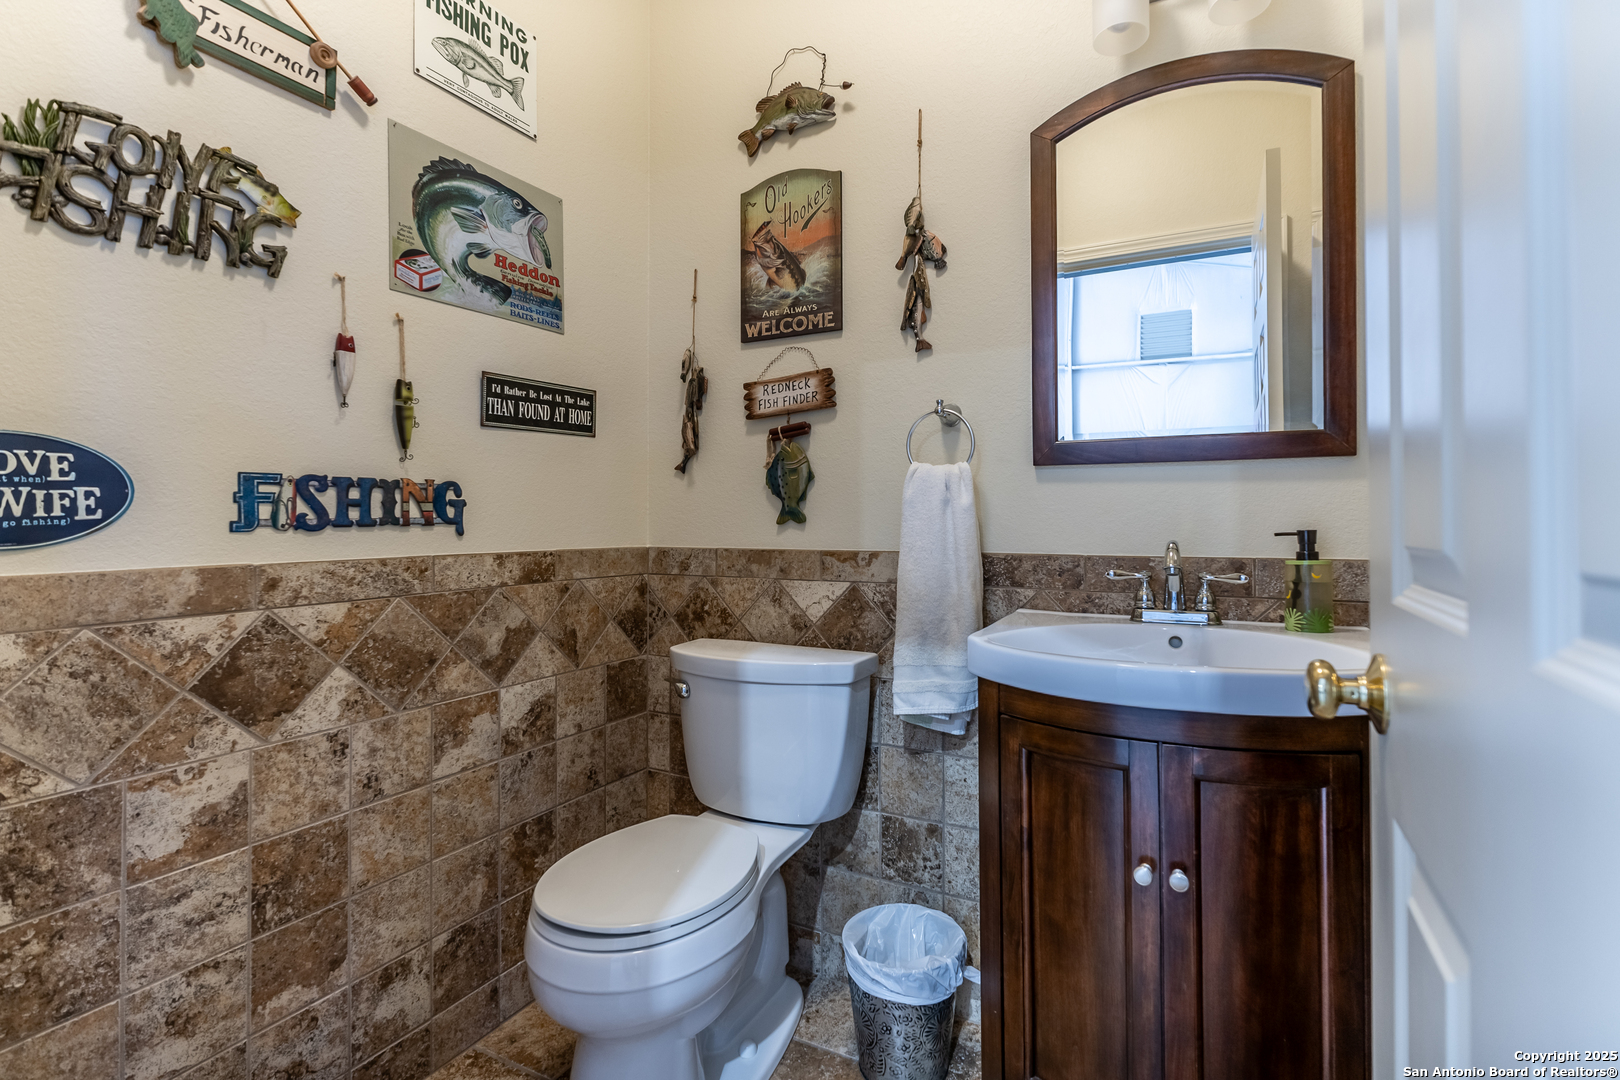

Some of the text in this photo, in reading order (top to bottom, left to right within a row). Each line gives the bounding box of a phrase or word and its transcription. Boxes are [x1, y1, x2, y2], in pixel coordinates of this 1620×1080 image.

[461, 0, 528, 44] RNING
[198, 5, 319, 83] Fisherman
[500, 33, 529, 73] POX
[52, 100, 262, 195] GONE
[765, 176, 788, 213] Old
[777, 179, 833, 238] Hookers
[494, 253, 560, 288] Heddon
[501, 274, 529, 291] Fishing
[530, 283, 553, 297] Tackle
[745, 311, 836, 338] WELCOME
[491, 383, 590, 406] I'd Rather Be Lost At The Lake
[758, 391, 818, 411] FISH FINDER
[762, 377, 811, 396] REDNECK
[487, 397, 592, 426] THAN FOUND AT HOME
[13, 475, 45, 483] when)
[0, 486, 102, 520] WIFE
[229, 471, 467, 536] FISHING
[2, 517, 70, 528] go fishing)
